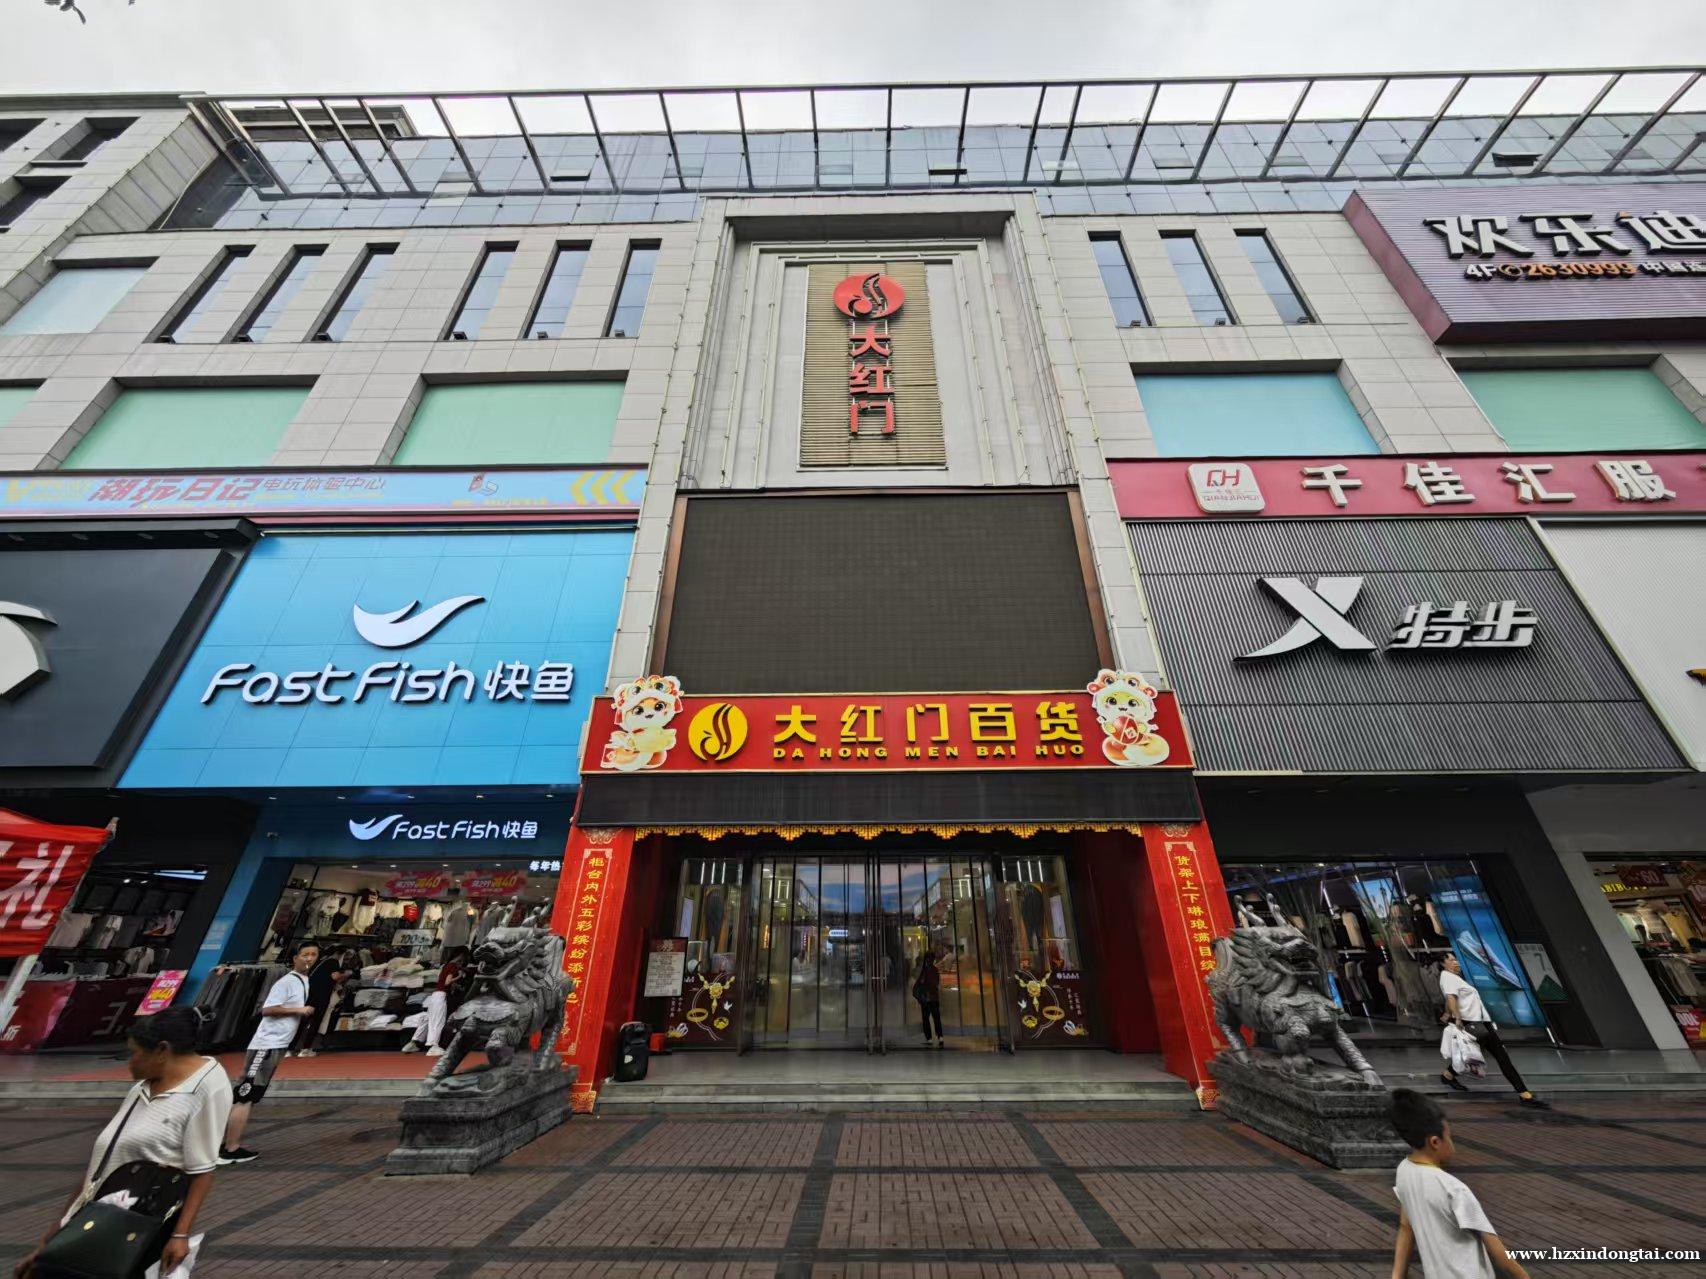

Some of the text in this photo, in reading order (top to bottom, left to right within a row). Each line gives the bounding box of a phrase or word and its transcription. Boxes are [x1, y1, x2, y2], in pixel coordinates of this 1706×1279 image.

[848, 324, 896, 437] 大红门
[1301, 459, 1706, 509] 千佳汇服
[1386, 600, 1538, 652] 特步
[201, 659, 575, 705] Fast Fish 快鱼
[773, 701, 1084, 745] 大红门百货
[773, 743, 1086, 762] DA HONG MEN BAI HUO
[392, 819, 539, 841] Fast Fish 快鱼
[0, 841, 75, 930] 礼
